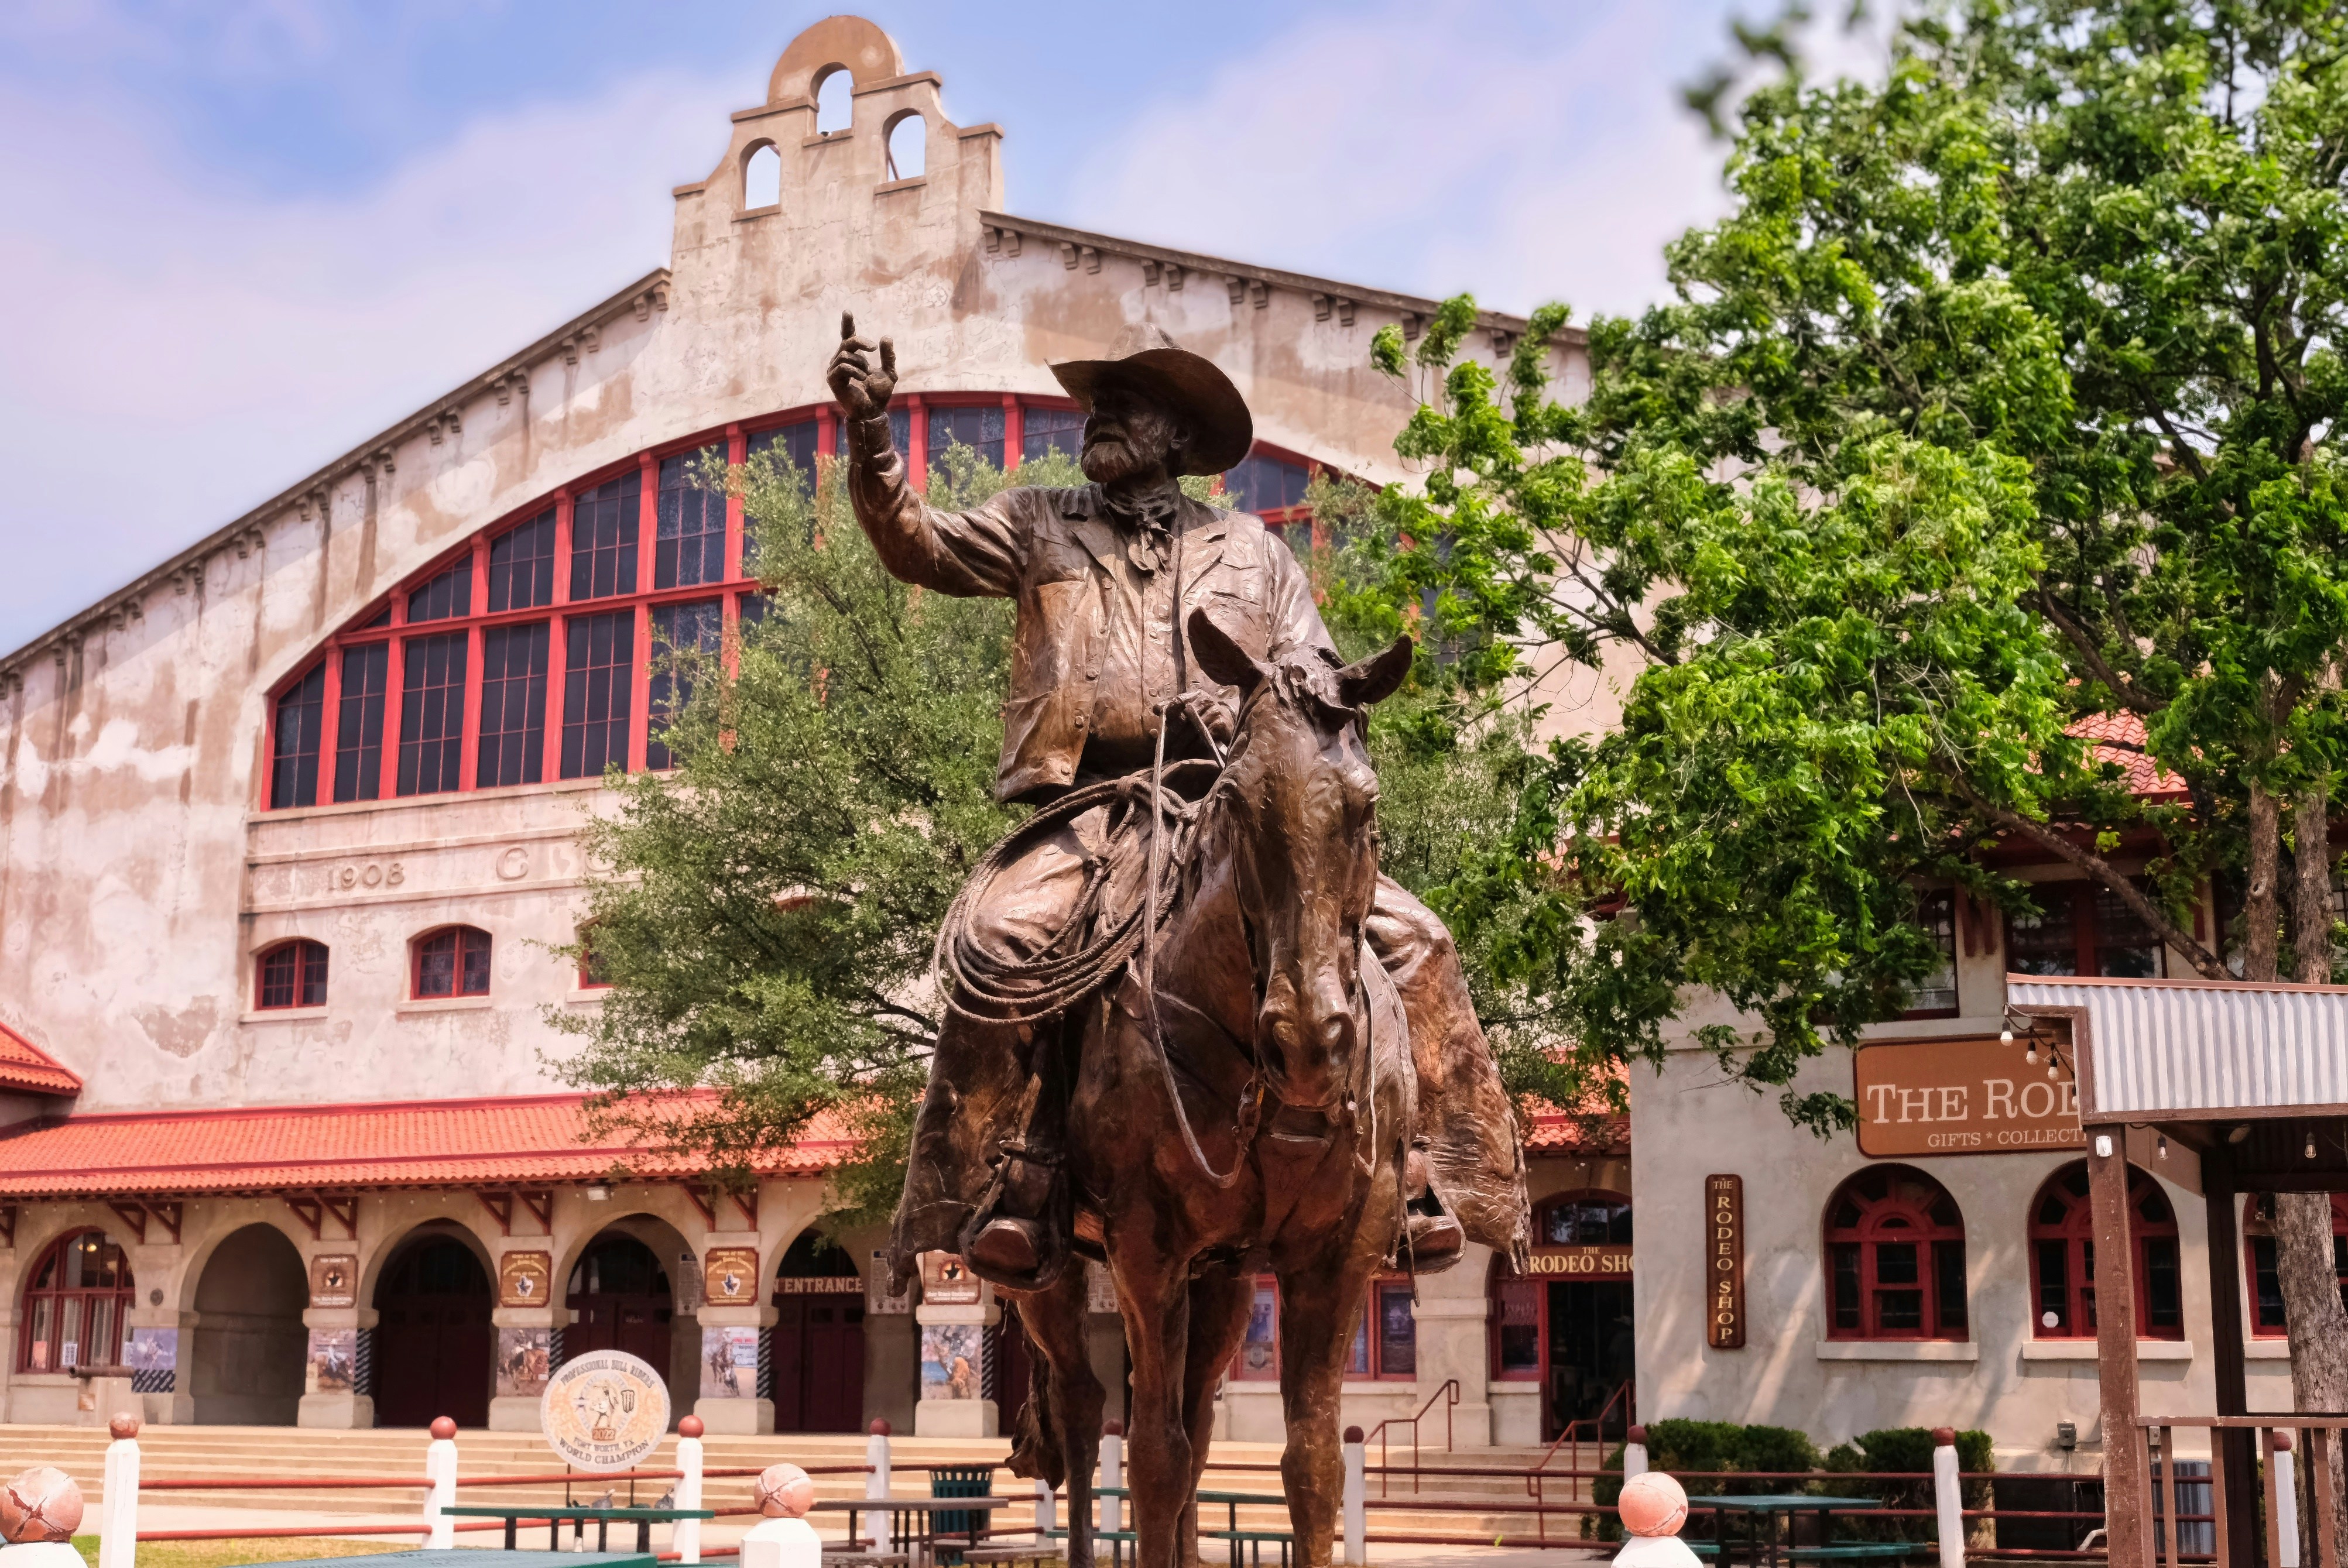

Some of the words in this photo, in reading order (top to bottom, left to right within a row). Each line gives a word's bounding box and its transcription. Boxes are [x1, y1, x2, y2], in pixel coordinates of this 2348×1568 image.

[327, 862, 405, 893] 1908
[1867, 1084, 1967, 1124] THE
[1928, 1133, 1981, 1148] GIFTS
[1713, 1180, 1733, 1189] THE
[1716, 1196, 1733, 1271] RODEO
[1530, 1255, 1595, 1273] RODEO
[784, 1277, 863, 1293] ENTRANCE
[1716, 1281, 1735, 1340] SHOP
[560, 1360, 608, 1386] PROFESSIONAL
[611, 1359, 628, 1373] BULL
[630, 1365, 655, 1388] RIDERS
[560, 1437, 592, 1463] WORLD
[594, 1438, 649, 1464] CHAMPION
[574, 1437, 592, 1450] FORT
[623, 1439, 635, 1447] TX
